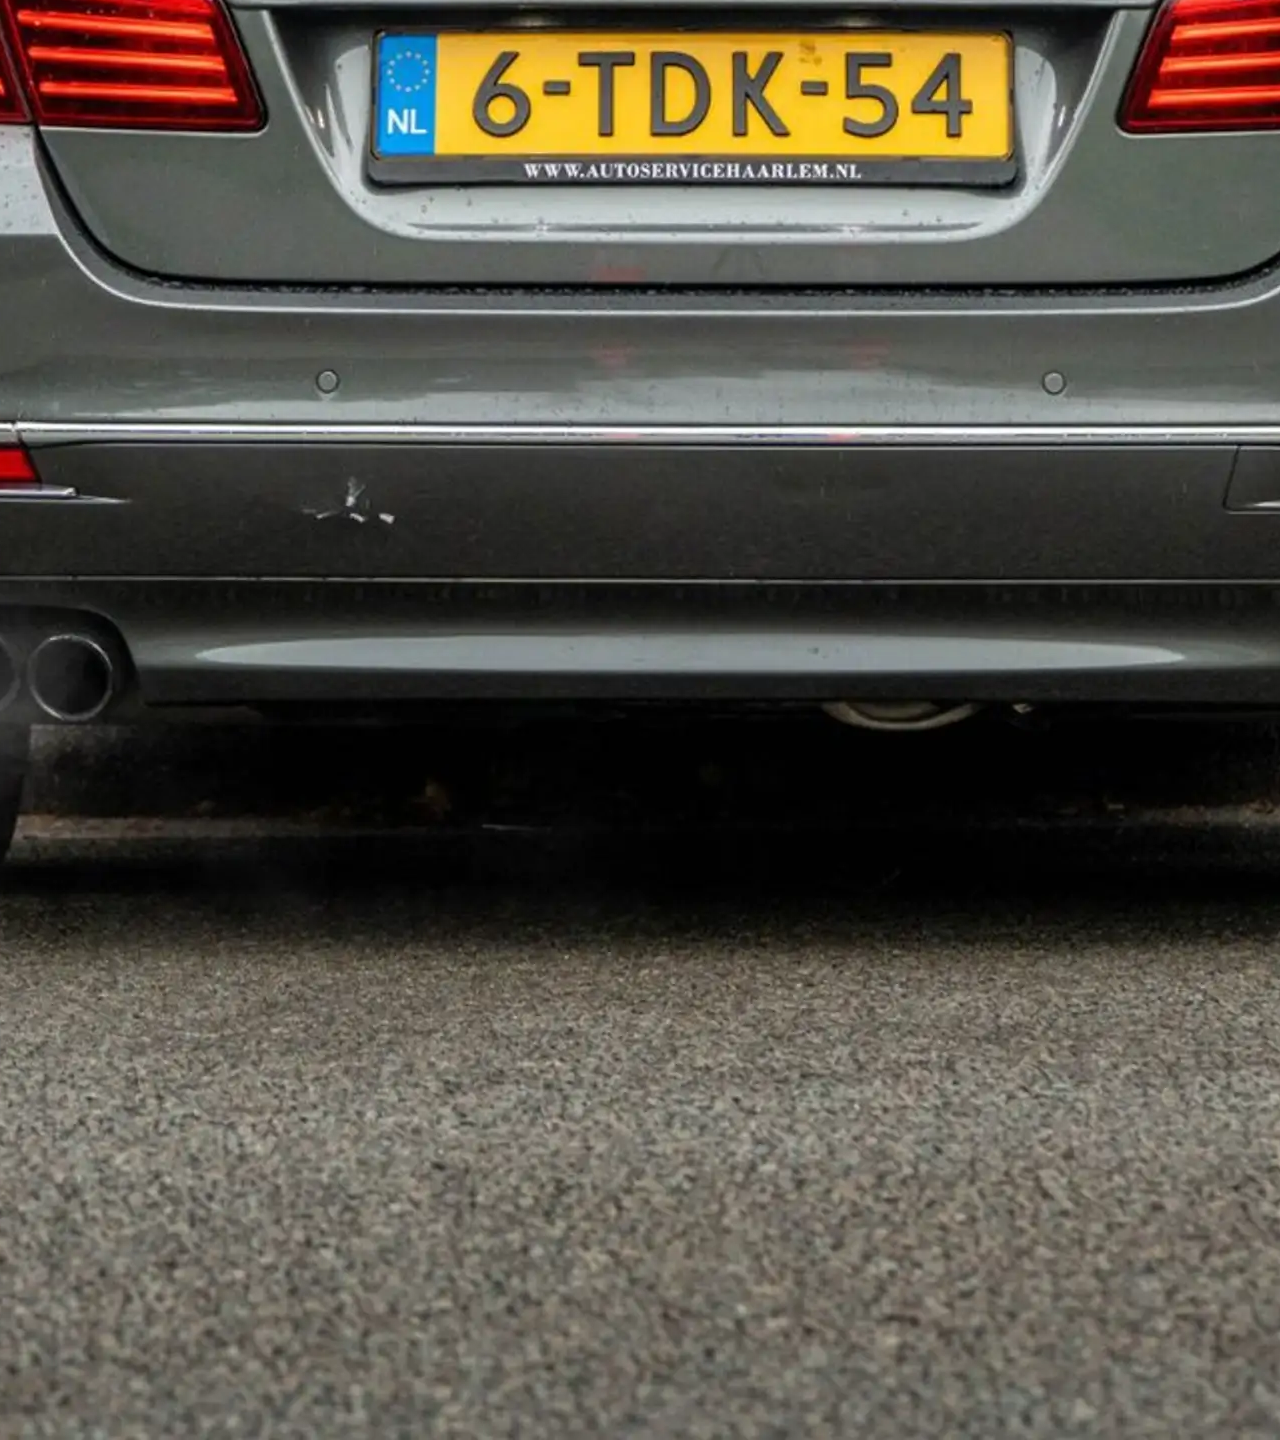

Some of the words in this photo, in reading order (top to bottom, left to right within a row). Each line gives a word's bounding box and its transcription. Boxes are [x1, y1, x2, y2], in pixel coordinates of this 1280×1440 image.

[472, 51, 973, 138] 6-TDK-54
[387, 109, 427, 135] NL
[524, 163, 863, 180] WWW.AUTOSERVICEHAARLEM.NL
